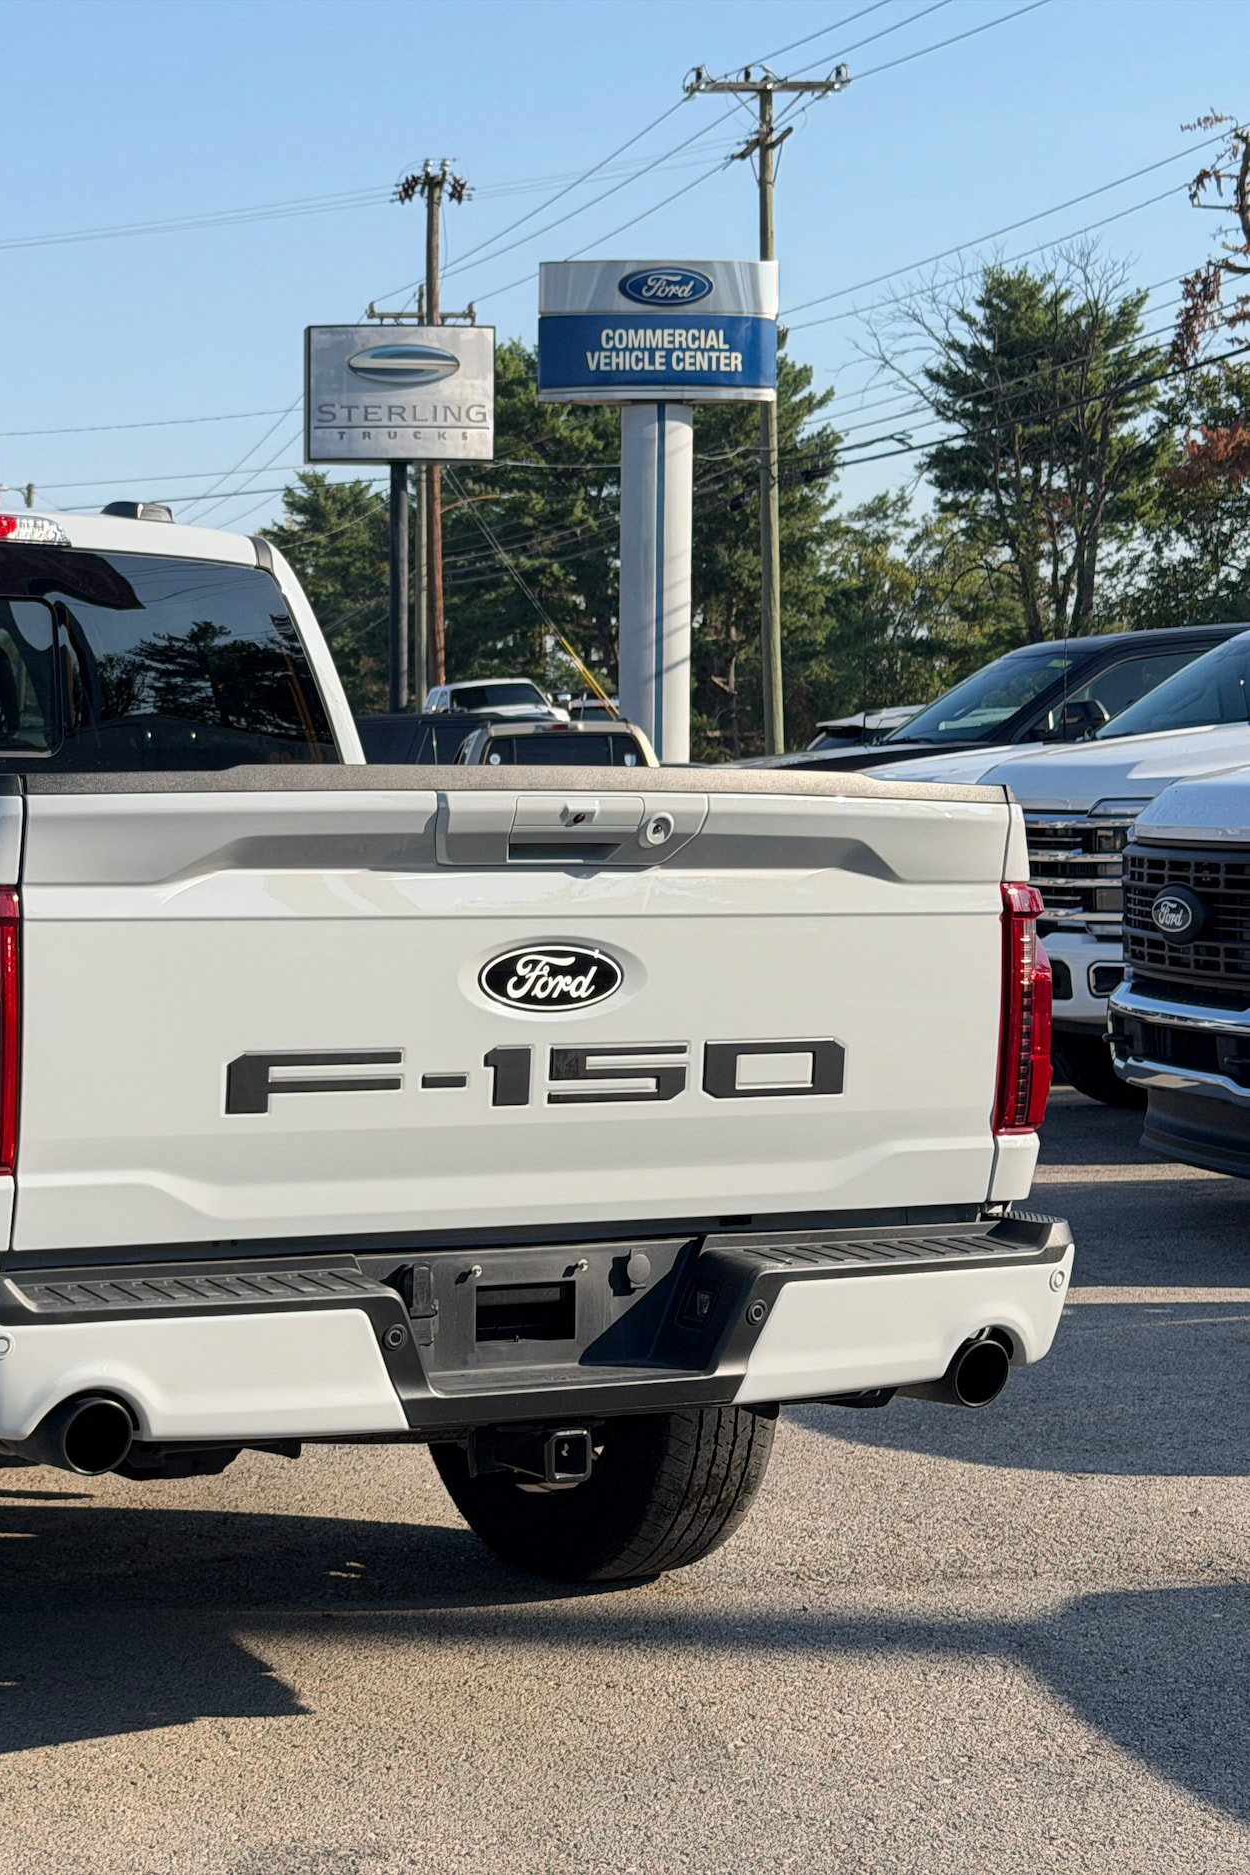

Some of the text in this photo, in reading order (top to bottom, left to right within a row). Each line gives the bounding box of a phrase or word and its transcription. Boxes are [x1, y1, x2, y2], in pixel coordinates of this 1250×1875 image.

[601, 328, 730, 350] COMMERCIAL
[586, 351, 743, 372] VEHICLE CENTER
[316, 403, 488, 423] STERLING
[337, 430, 468, 441] TRUCKS
[506, 953, 596, 1000] Ford
[224, 1037, 846, 1116] F-150
